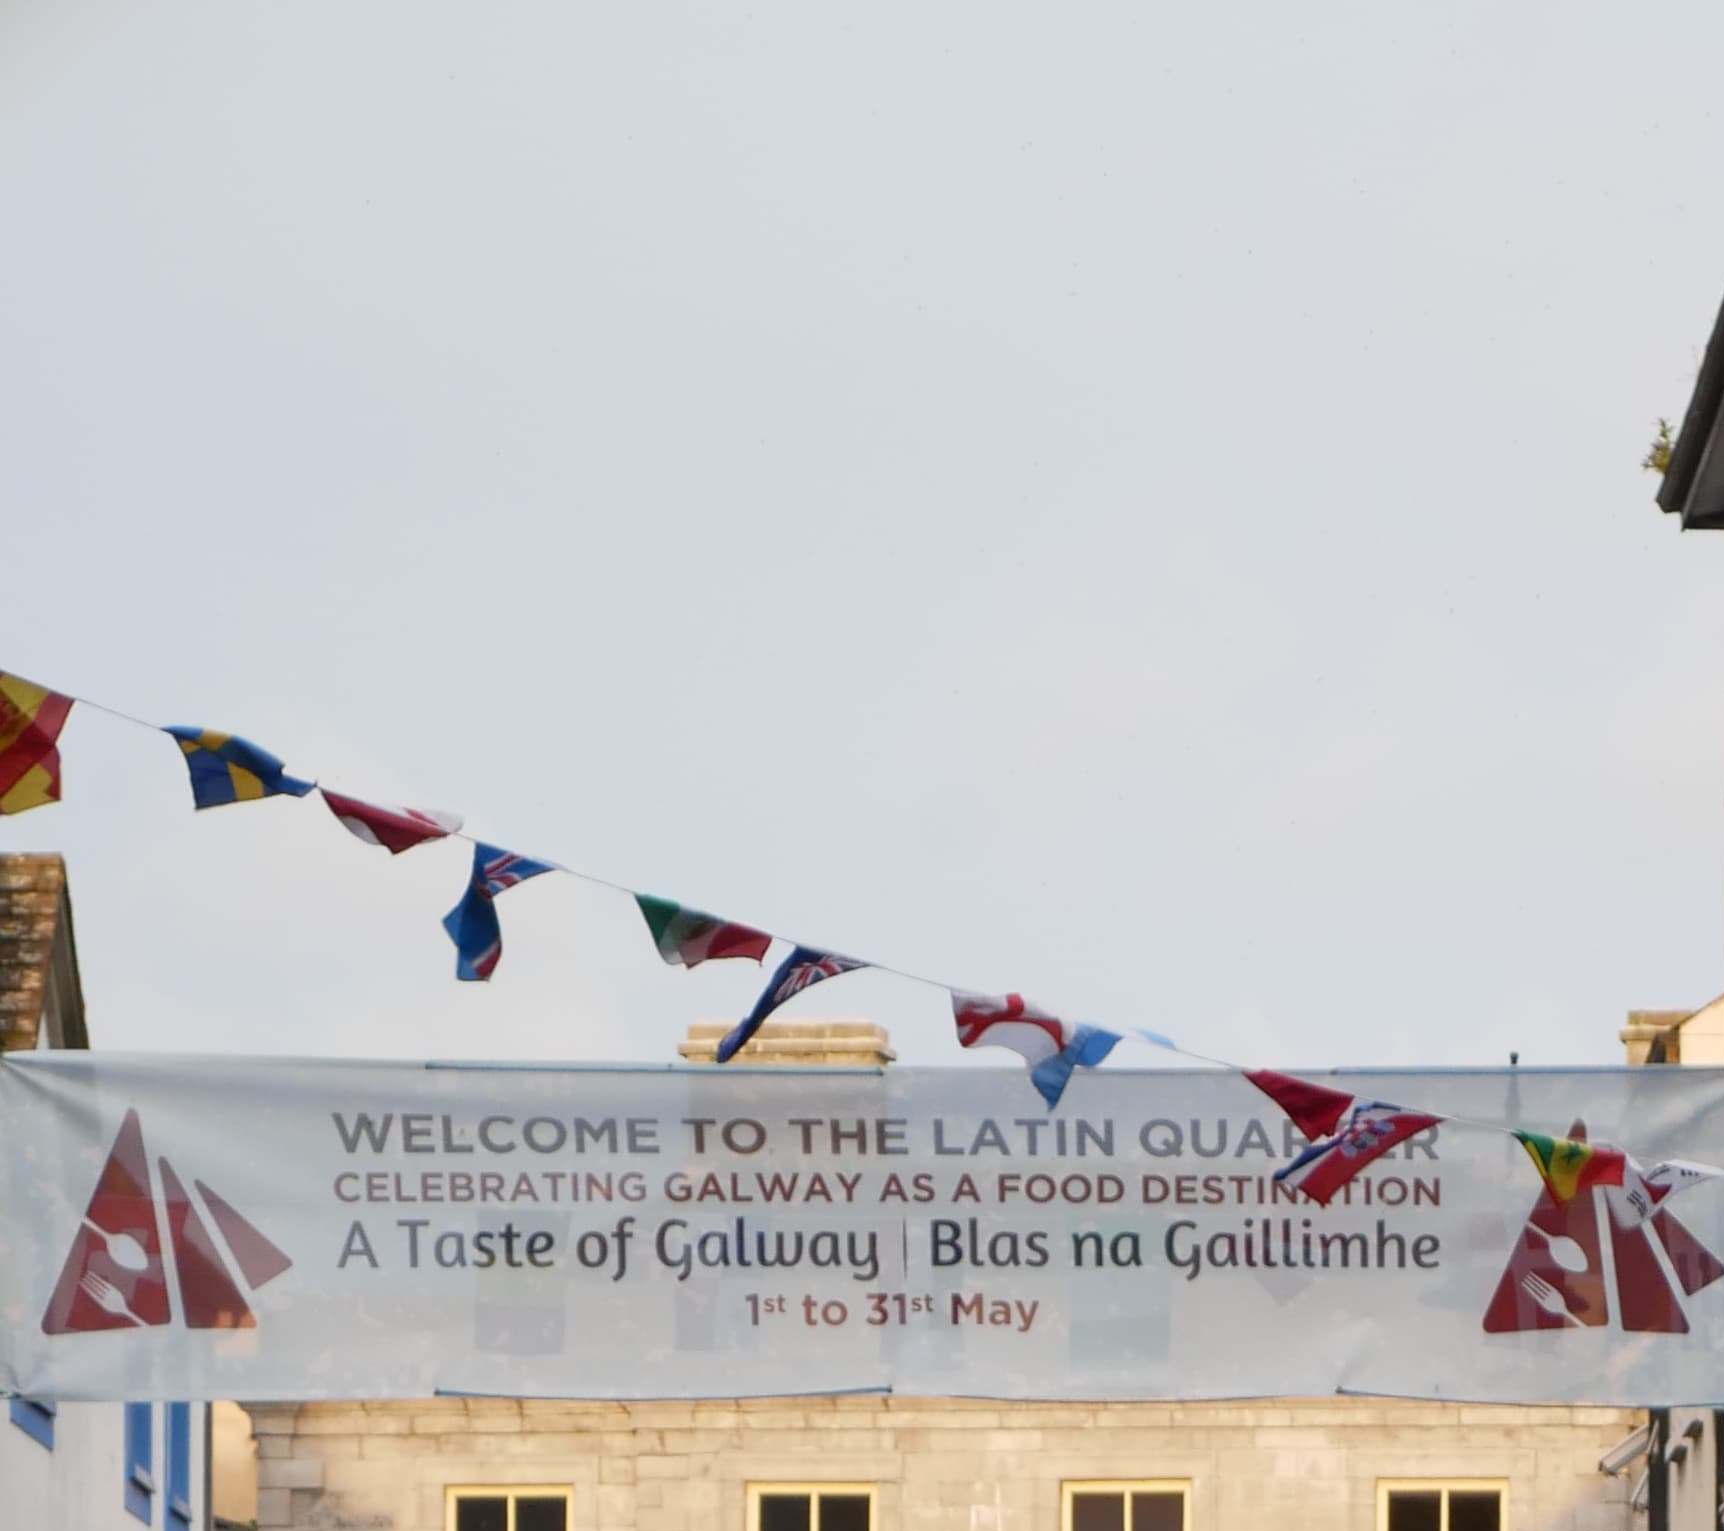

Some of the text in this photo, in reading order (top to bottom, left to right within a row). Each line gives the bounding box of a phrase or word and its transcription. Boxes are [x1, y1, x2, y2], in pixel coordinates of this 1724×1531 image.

[332, 1112, 660, 1155] WELCOME
[681, 1117, 767, 1155] TO
[789, 1118, 908, 1156] THE
[934, 1118, 1115, 1157] LATIN
[334, 1172, 1441, 1208] CELEBRATING GALWAY AS A FOOD DESTINTION
[337, 1216, 1440, 1282] A Taste of Galway Blas na Gaillimhe
[745, 1293, 1039, 1333] 1st to 31st May
